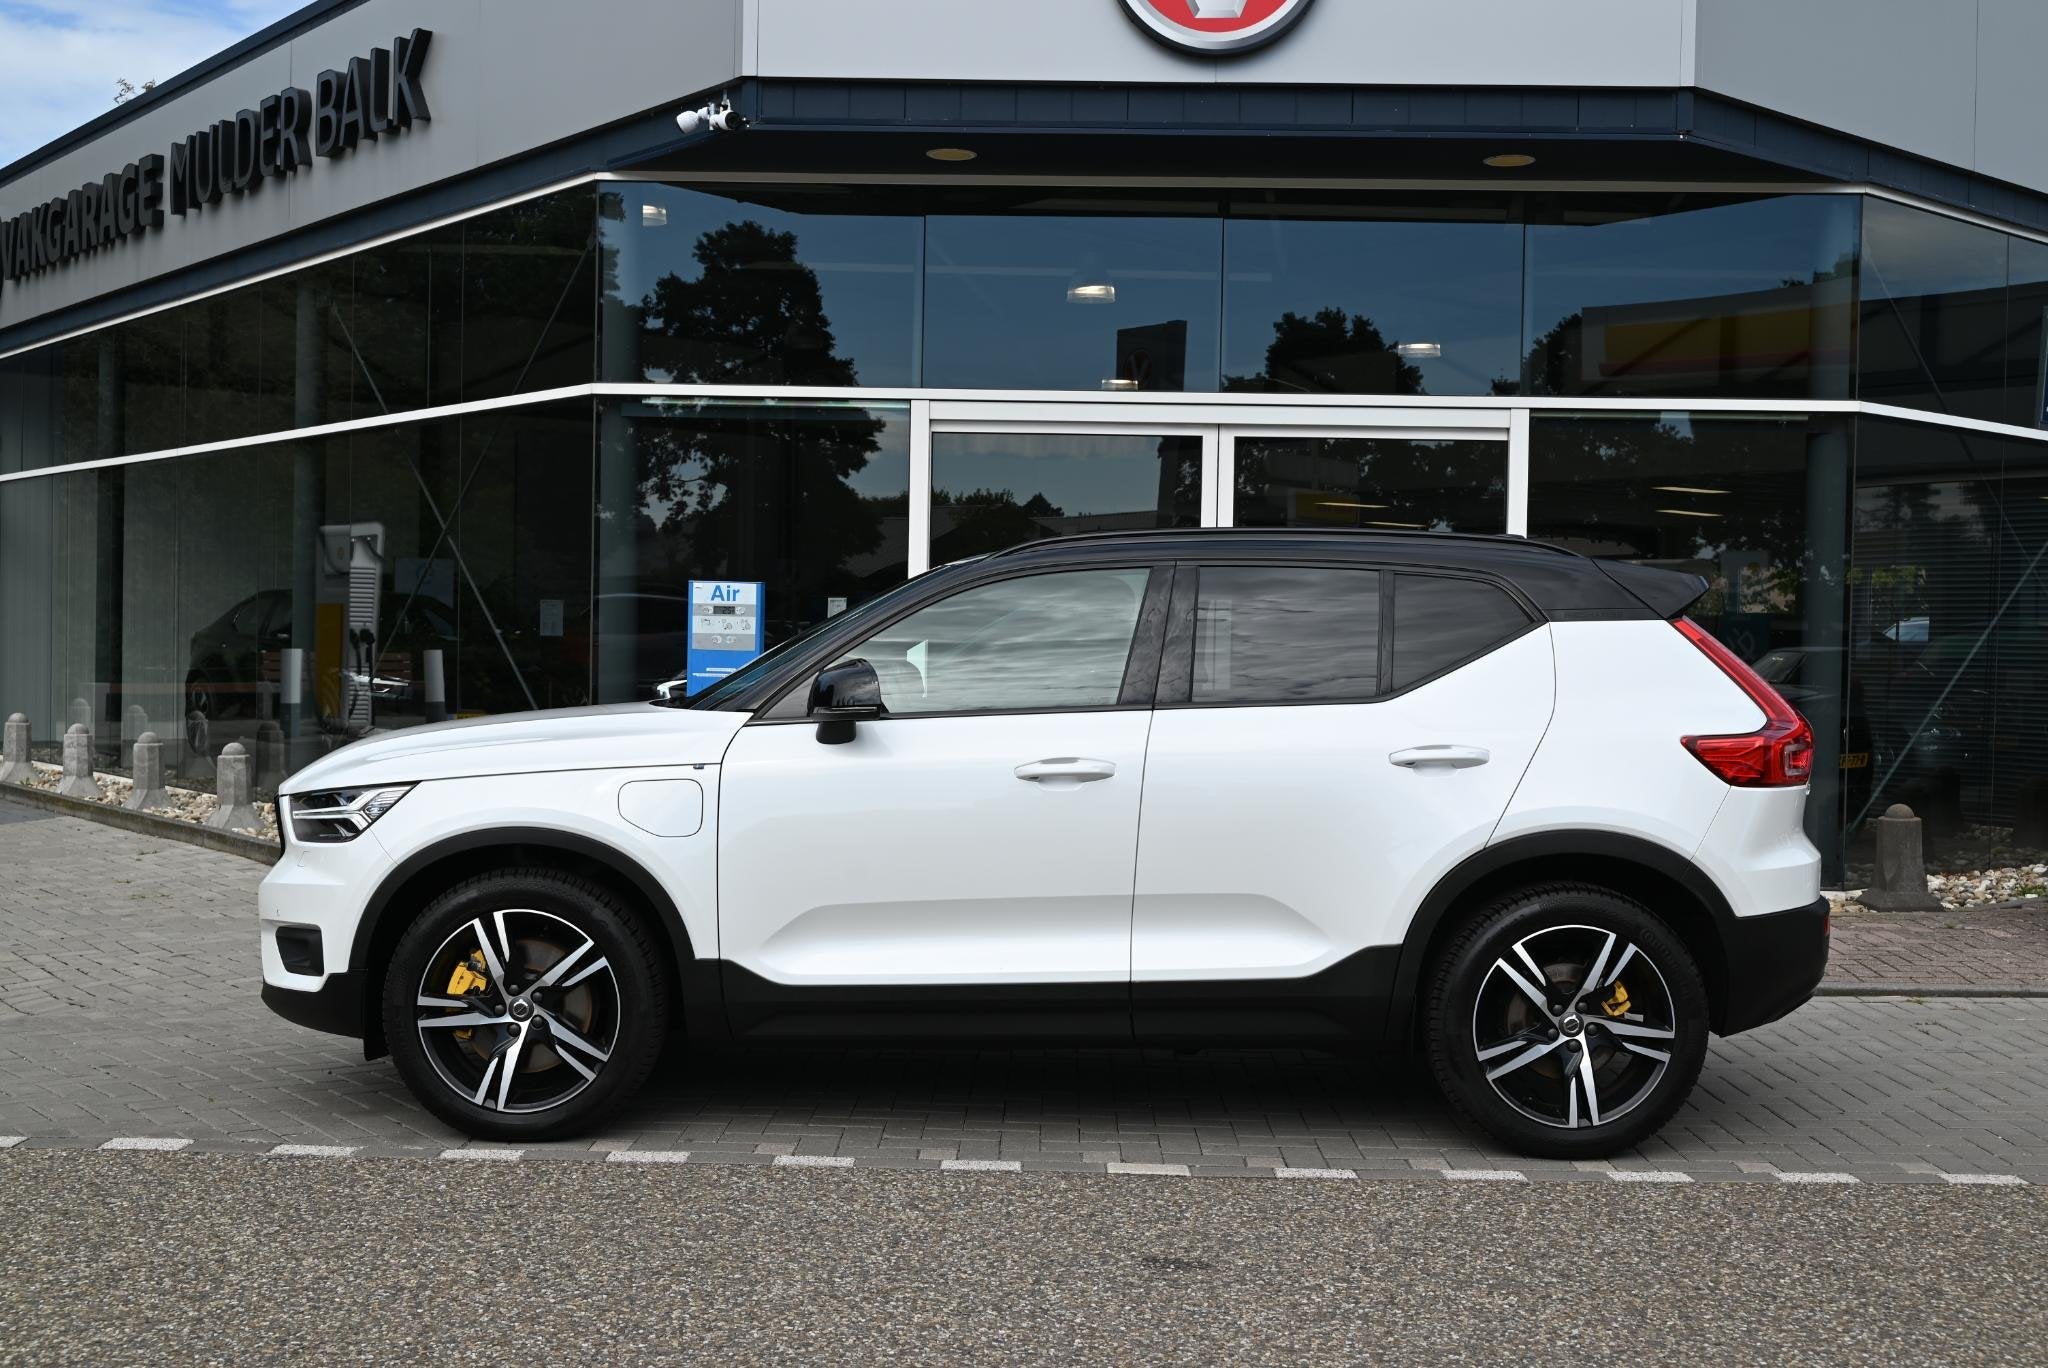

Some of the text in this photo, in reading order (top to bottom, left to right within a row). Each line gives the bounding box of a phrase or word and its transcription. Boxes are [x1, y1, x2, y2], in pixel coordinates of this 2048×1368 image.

[0, 27, 433, 281] VAKGARAGE MULDER BALK
[710, 584, 741, 602] Air
